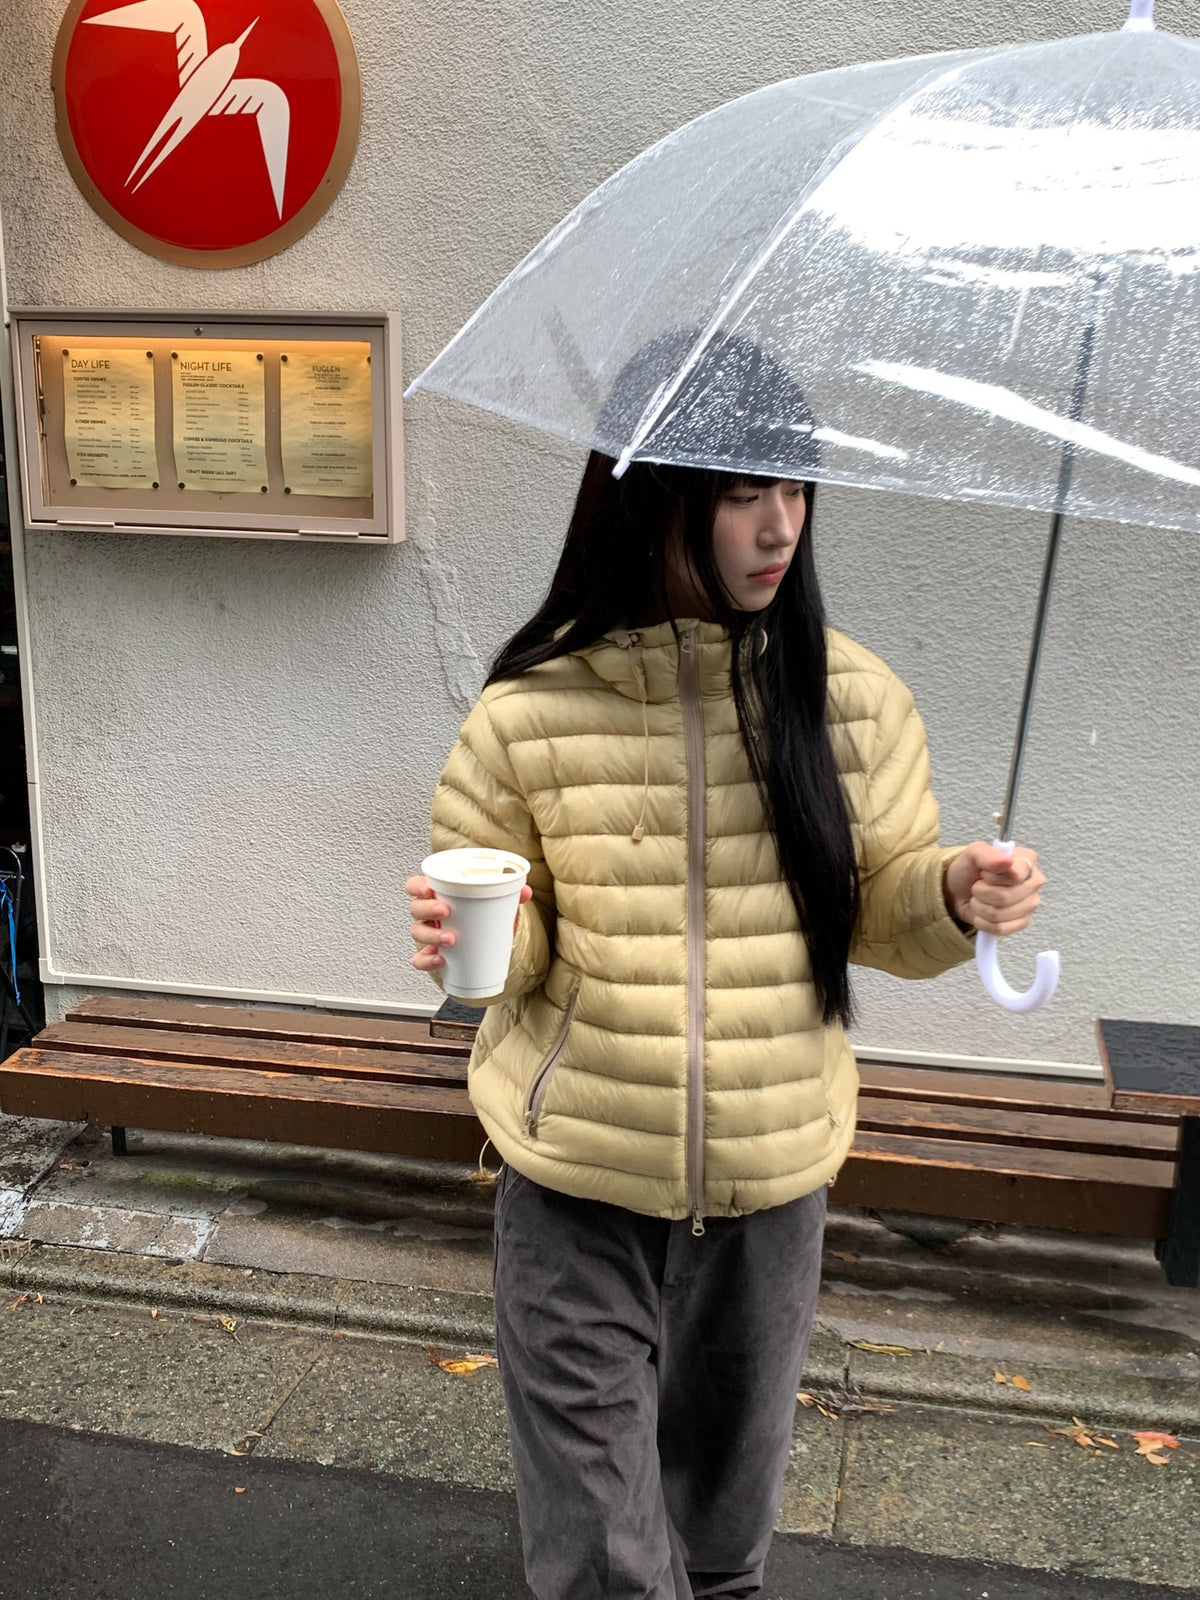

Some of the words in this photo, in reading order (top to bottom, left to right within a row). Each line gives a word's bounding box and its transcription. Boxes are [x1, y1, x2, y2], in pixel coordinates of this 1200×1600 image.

[71, 359, 88, 369] DAY
[91, 360, 110, 370] LIFE
[180, 362, 210, 371] NIGHT
[212, 362, 232, 372] LIFE
[312, 365, 341, 373] FUGLEN
